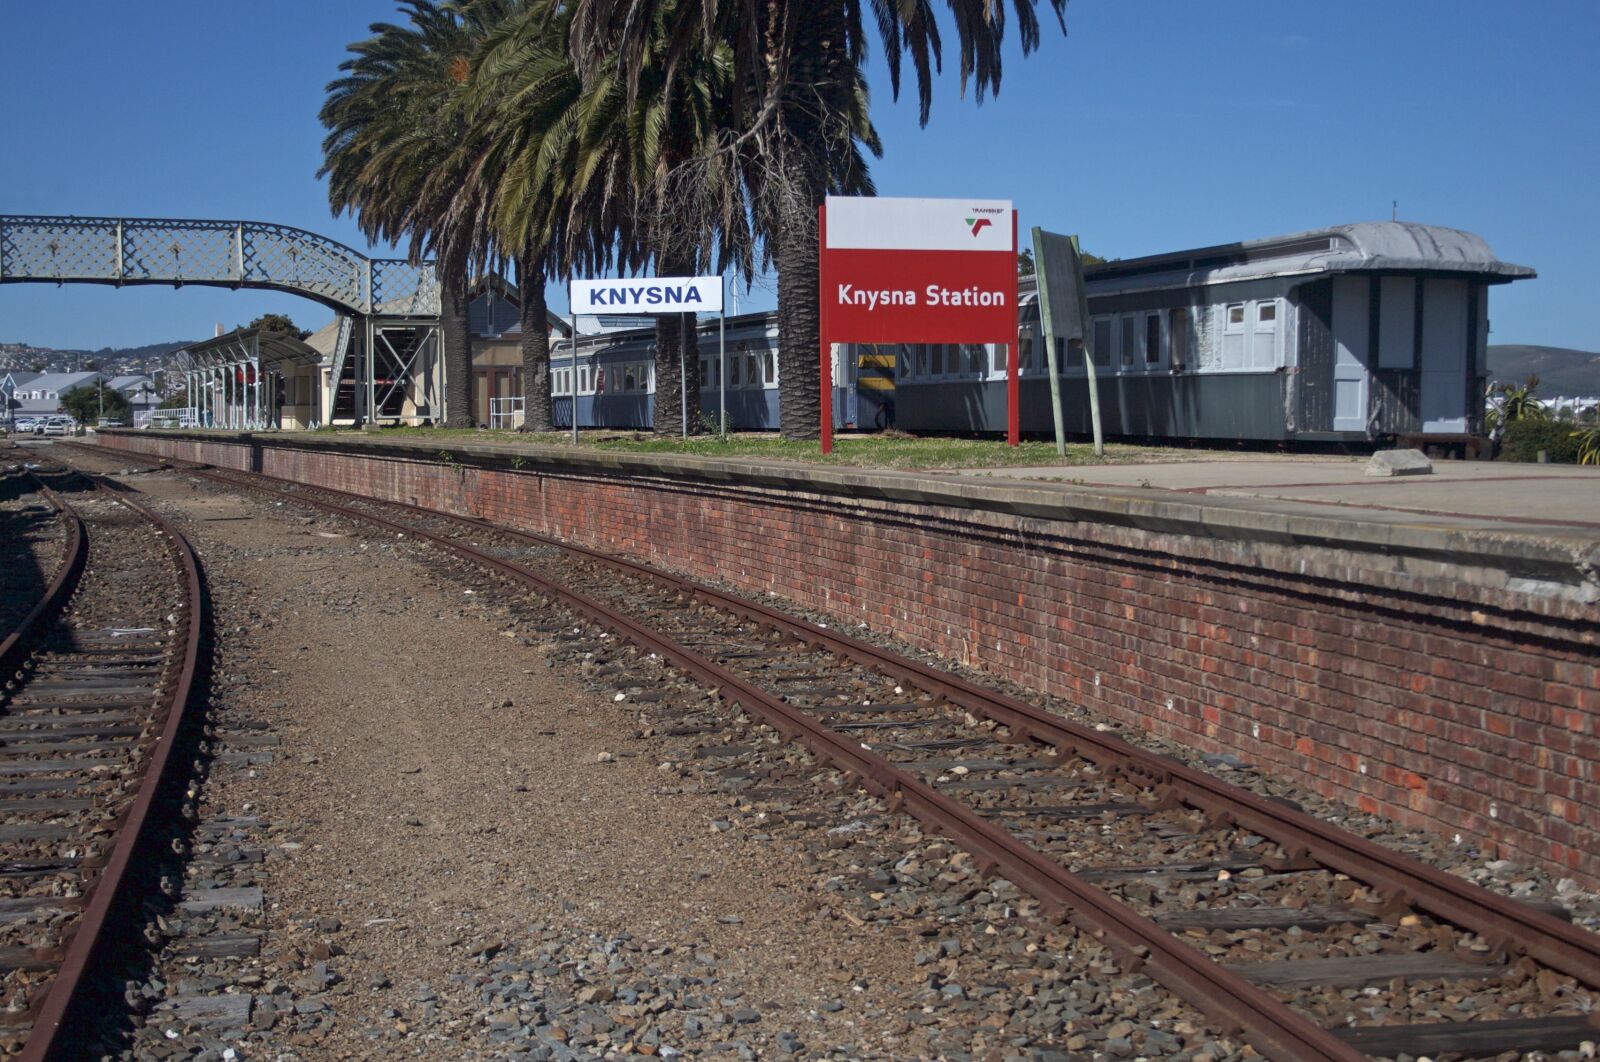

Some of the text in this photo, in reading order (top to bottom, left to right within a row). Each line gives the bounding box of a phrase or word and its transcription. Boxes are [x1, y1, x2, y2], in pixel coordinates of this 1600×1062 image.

[590, 285, 702, 306] KNYSNA
[838, 283, 1005, 311] Knysna Station
